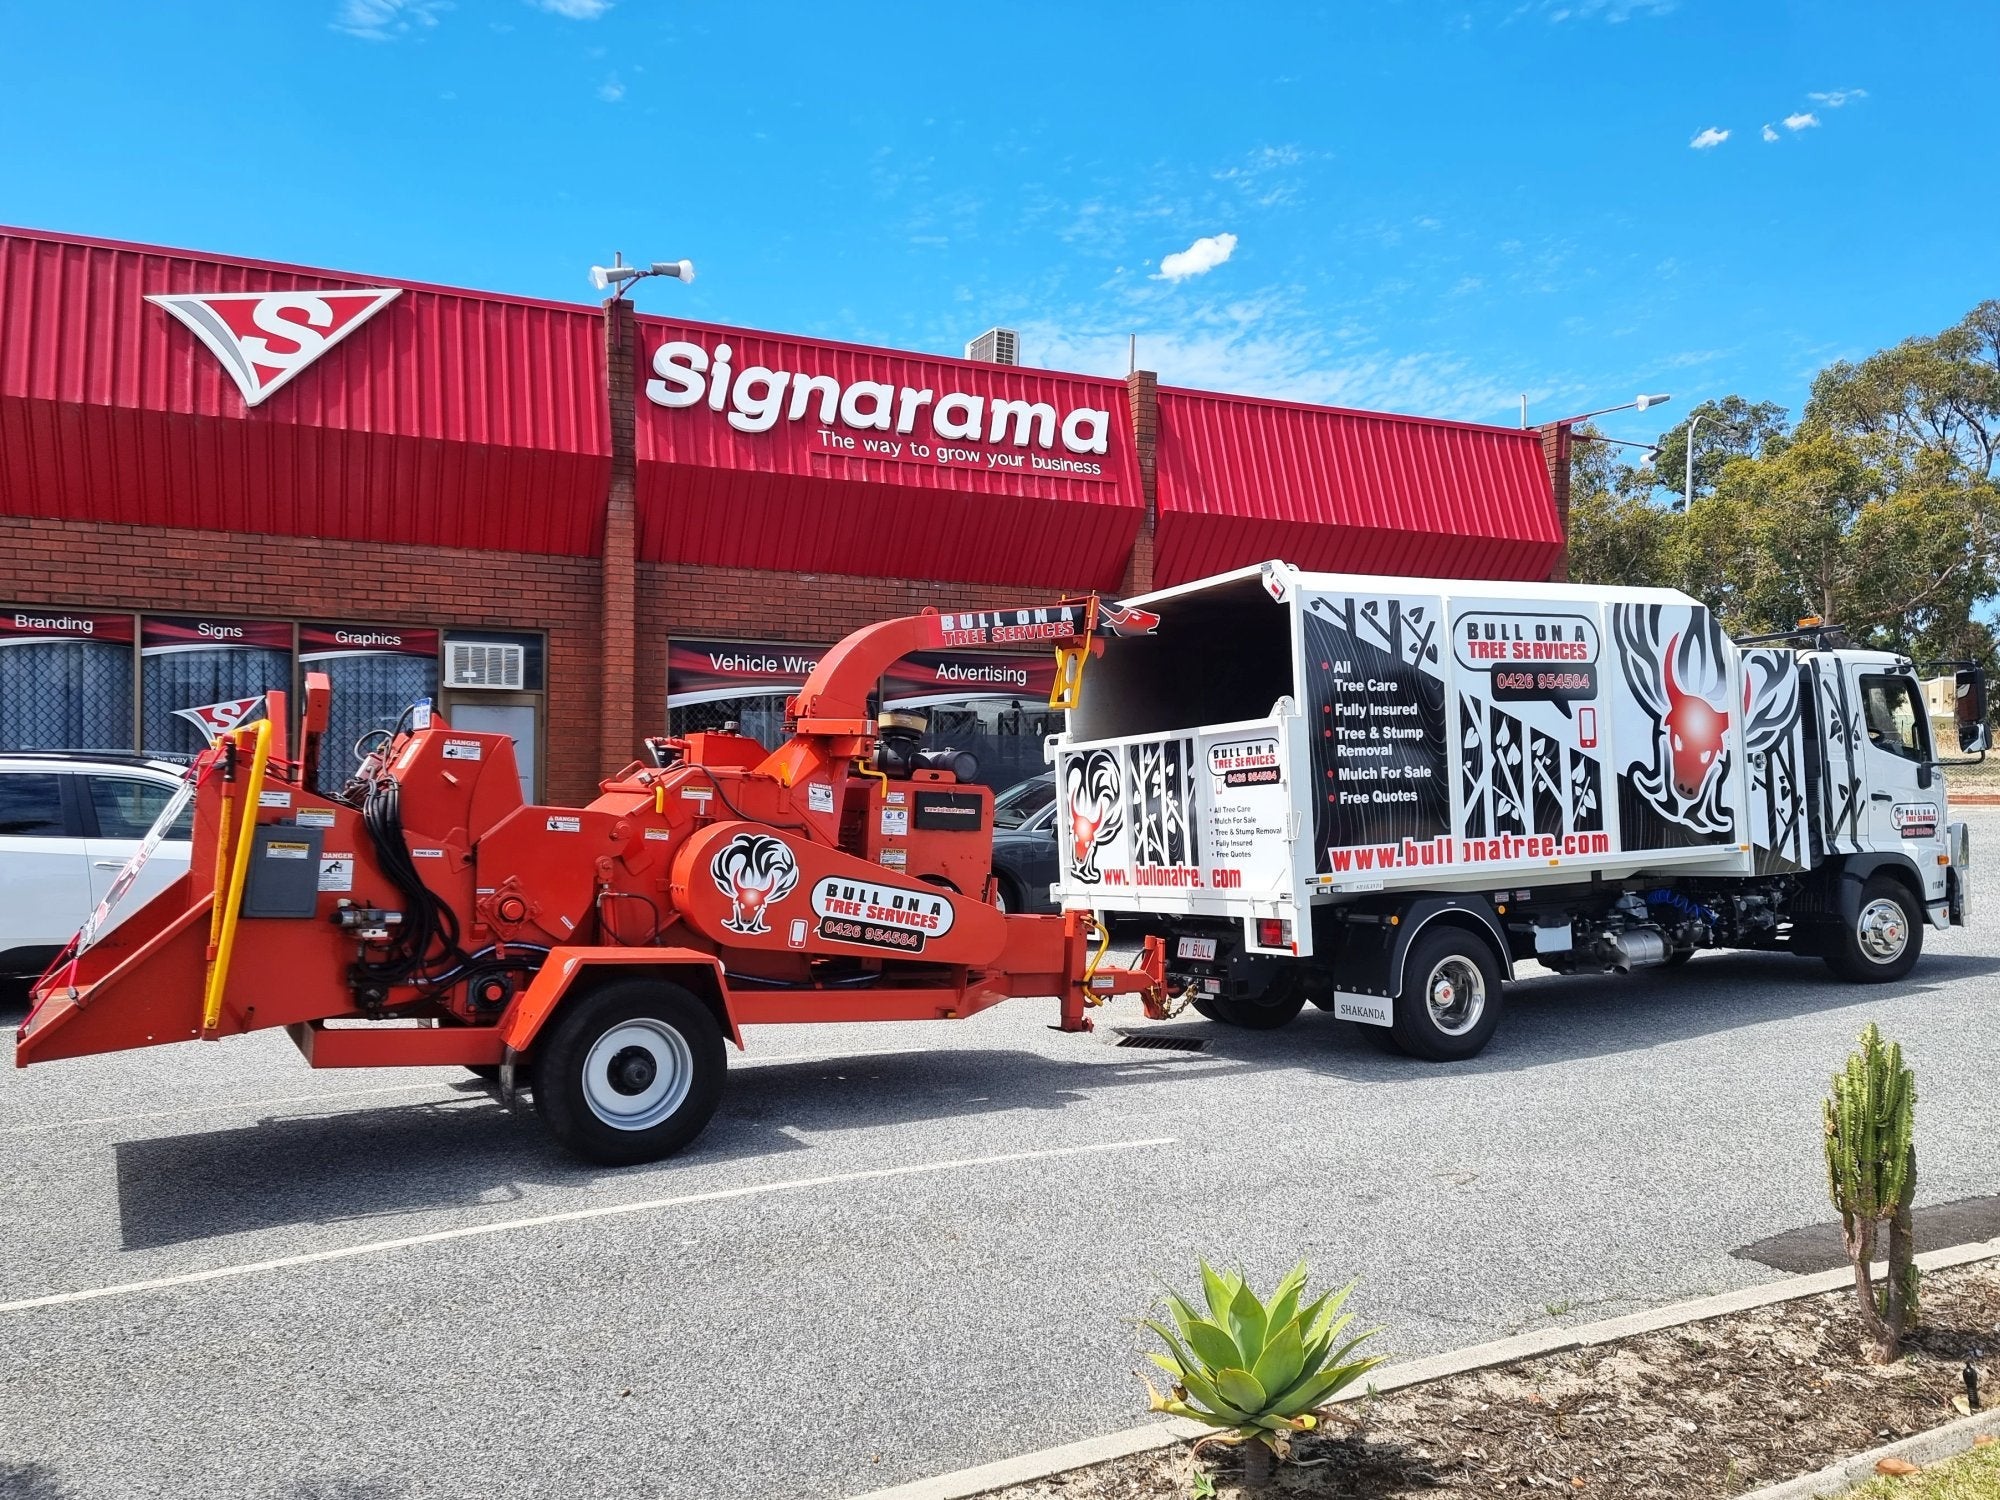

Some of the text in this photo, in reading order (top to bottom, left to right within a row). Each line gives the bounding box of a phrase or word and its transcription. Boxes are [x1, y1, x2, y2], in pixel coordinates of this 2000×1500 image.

[645, 341, 1109, 454] Signarama
[817, 430, 1101, 475] The way to grow your business
[15, 614, 94, 634] Branding
[941, 607, 1073, 630] BULL ON A
[198, 623, 243, 639] Signs
[335, 631, 401, 646] Graphics
[942, 621, 1075, 646] TREE SERVICES
[1467, 623, 1586, 642] BULL ON A
[1468, 642, 1588, 660] TREE SERVICES
[710, 653, 778, 672] Vehicle
[1334, 661, 1351, 674] All
[936, 663, 1027, 686] Advertising
[1497, 673, 1590, 689] 0426 954584
[1334, 679, 1398, 692] Tree Care
[1335, 703, 1418, 719] Fully Insured
[1336, 727, 1424, 741] Tree & Stump
[1214, 744, 1275, 759] BULL ON A
[1338, 744, 1393, 757] Removal
[1215, 755, 1276, 770] TREE SERVICES
[1339, 766, 1432, 781] Mulch For Sale
[1340, 790, 1418, 805] Free Quotes
[1235, 828, 1254, 836] Stump
[1216, 839, 1253, 848] Fully Insured
[1332, 834, 1609, 872] www.bullonatree.com
[826, 884, 941, 916] BULL ON A
[825, 898, 939, 930] TREE SERVICES
[825, 921, 917, 947] 0426 954584
[1192, 944, 1211, 958] BULL
[1341, 1005, 1386, 1021] SHAKANDA
